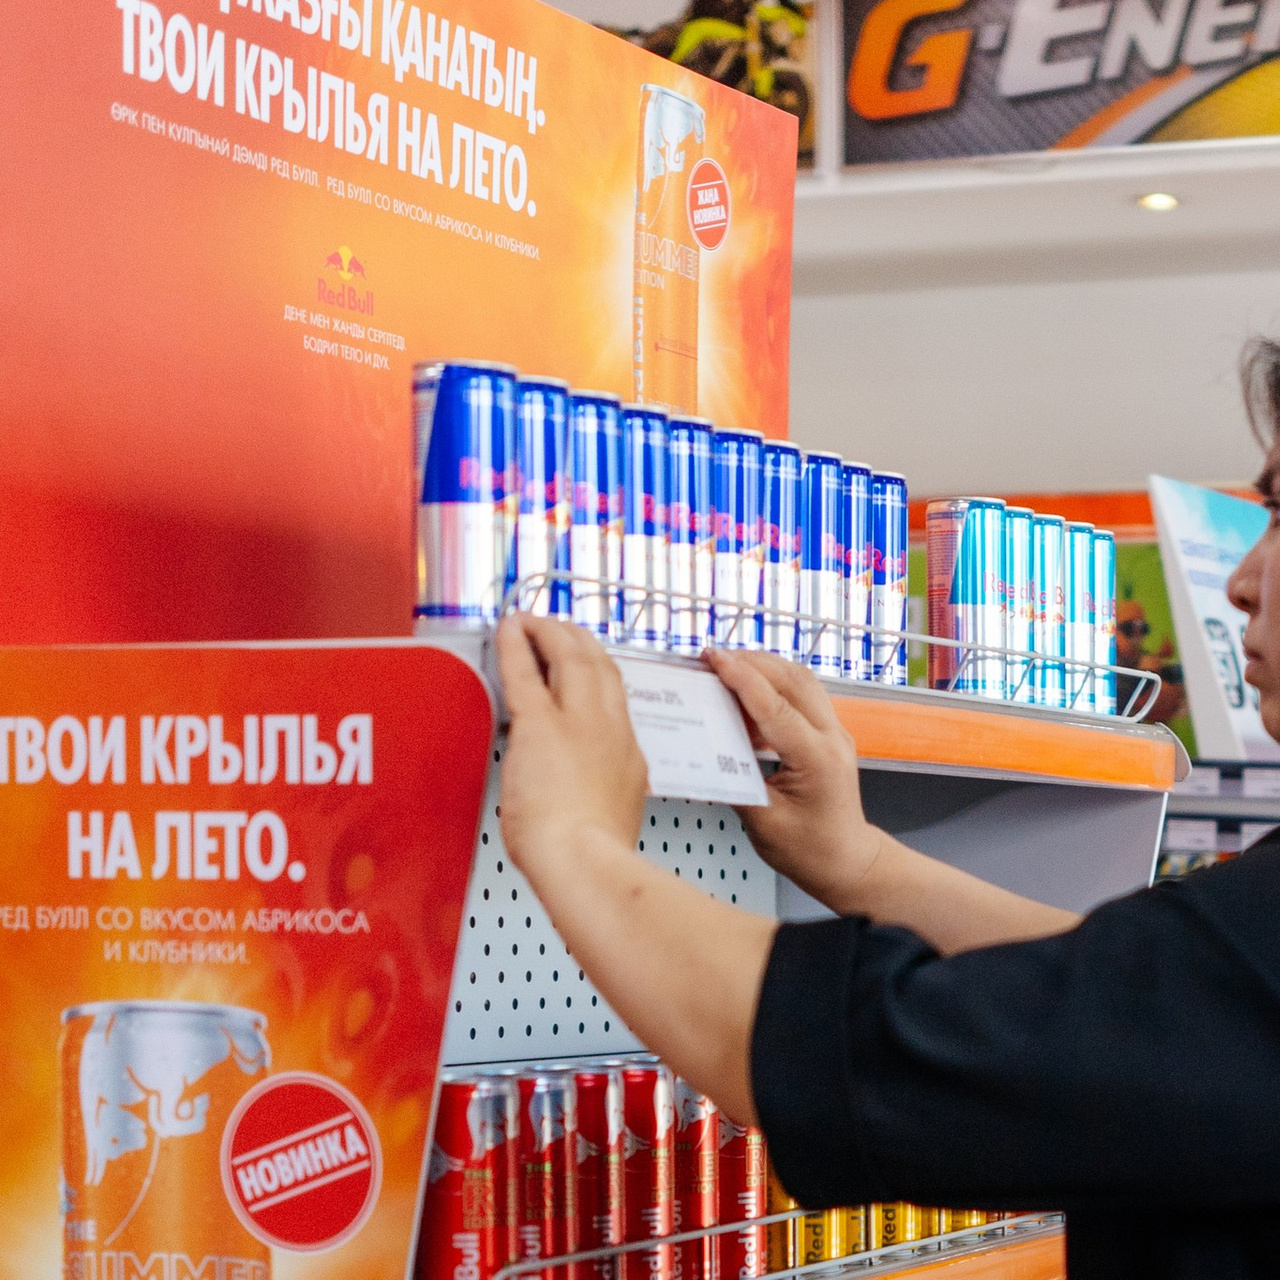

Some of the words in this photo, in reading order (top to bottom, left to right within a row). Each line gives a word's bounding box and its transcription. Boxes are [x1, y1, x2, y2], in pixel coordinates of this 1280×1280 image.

[381, 0, 546, 135] ҚАНАТЫҢ.
[116, 0, 225, 107] ТВОИ
[235, 37, 390, 166] КРЫЛЬЯ
[397, 101, 444, 184] НА
[449, 121, 537, 218] ЛЕТО.
[111, 101, 139, 126] ӨРІК
[141, 113, 166, 136] ПЕН
[232, 144, 268, 172] ДӘМДІ
[271, 156, 290, 179] РЕД
[292, 165, 320, 188] БУЛЛ.
[326, 176, 345, 197] РЕД
[347, 182, 372, 205] БУЛЛ
[374, 192, 391, 211] СО
[392, 199, 433, 225] ВКУСОМ
[434, 214, 484, 242] АБРИКОСА
[485, 231, 493, 243] И
[494, 233, 541, 261] КЛУБНИКИ.
[693, 204, 727, 225] НОВИНКА
[284, 304, 307, 324] ДЕНЕ
[309, 311, 330, 330] МЕН
[317, 277, 346, 309] Red
[347, 285, 374, 316] Bull
[303, 335, 338, 356] БОДРИТ
[340, 344, 364, 363] ТЕЛО
[364, 351, 373, 366] И
[372, 353, 391, 371] ДУХ.
[140, 714, 374, 785] КРЫЛЬЯ
[67, 811, 143, 880] НА
[152, 810, 306, 882] ЛЕТО.
[35, 905, 90, 930] БУЛЛ
[96, 906, 133, 931] СО
[140, 907, 236, 932] ВКУСОМ
[242, 908, 371, 934] АБРИКОСА
[103, 940, 122, 962] И
[128, 940, 248, 965] КЛУБНИКИ.
[237, 1124, 368, 1201] НОВИНКА
[641, 1206, 663, 1238] ull
[737, 1190, 758, 1226] ull
[518, 1224, 542, 1268] ull
[737, 1232, 757, 1280] Red
[805, 1220, 825, 1264] Red
